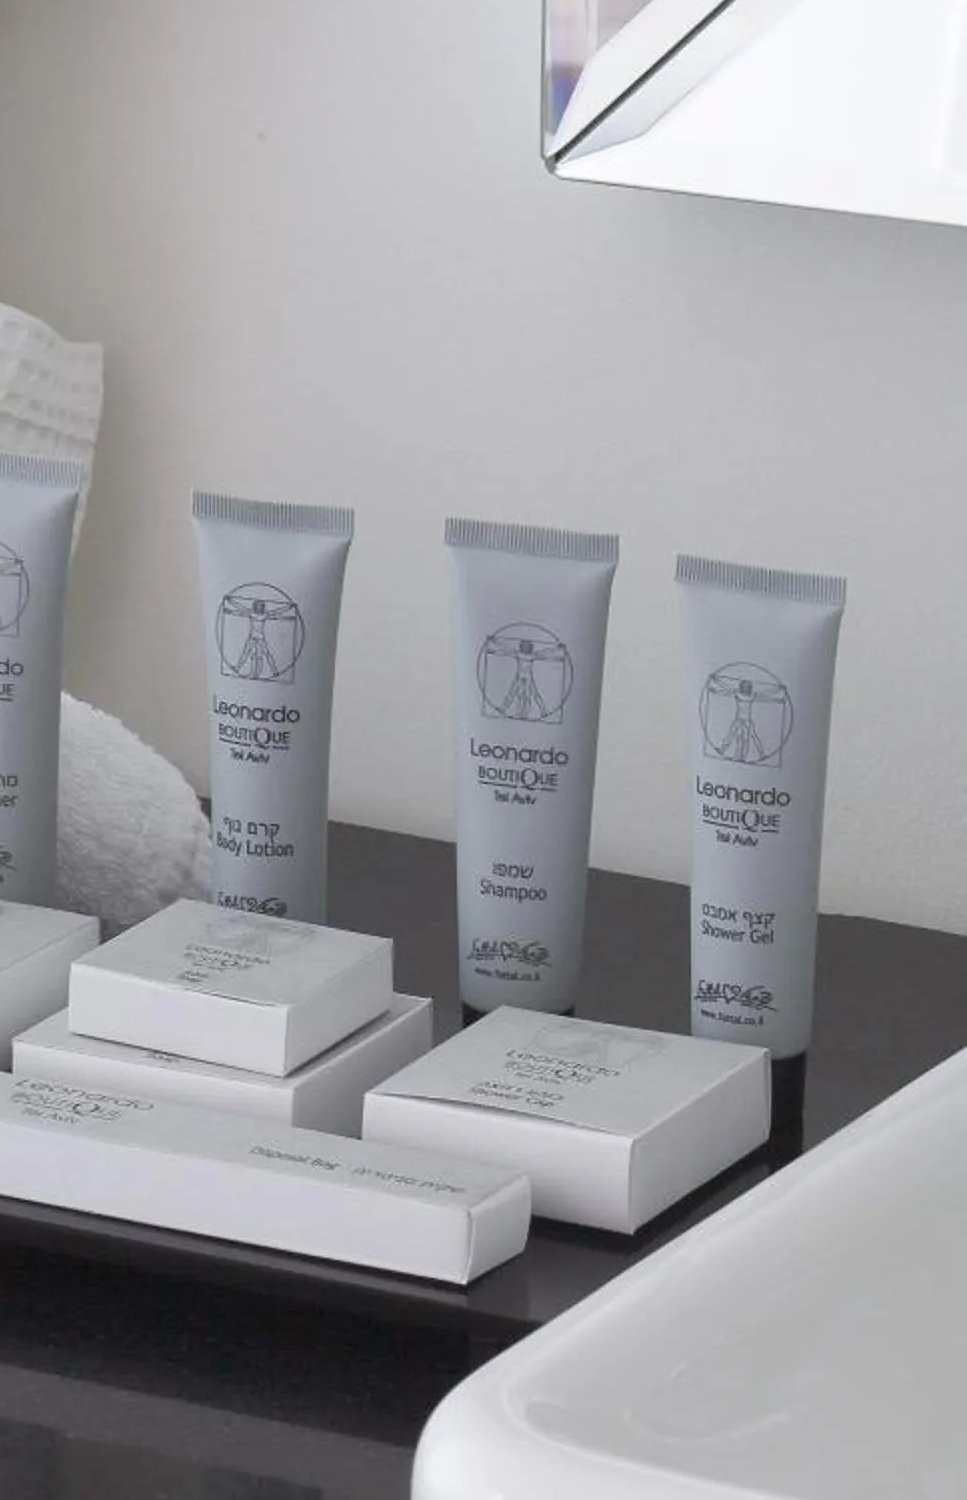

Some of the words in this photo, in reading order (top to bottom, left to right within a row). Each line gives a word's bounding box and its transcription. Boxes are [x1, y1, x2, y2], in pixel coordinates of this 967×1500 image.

[213, 693, 301, 724] Leonardo
[218, 722, 291, 750] BOUTIQUE
[469, 737, 570, 766] Leonardo
[478, 765, 559, 792] BOUTIQUE
[696, 774, 792, 807] Leonardo
[702, 803, 781, 832] BOUTIQUE
[216, 831, 242, 857] Body
[246, 840, 295, 858] Lotion
[480, 878, 549, 904] Shampoo
[700, 919, 745, 942] Shower
[750, 929, 775, 945] Gel
